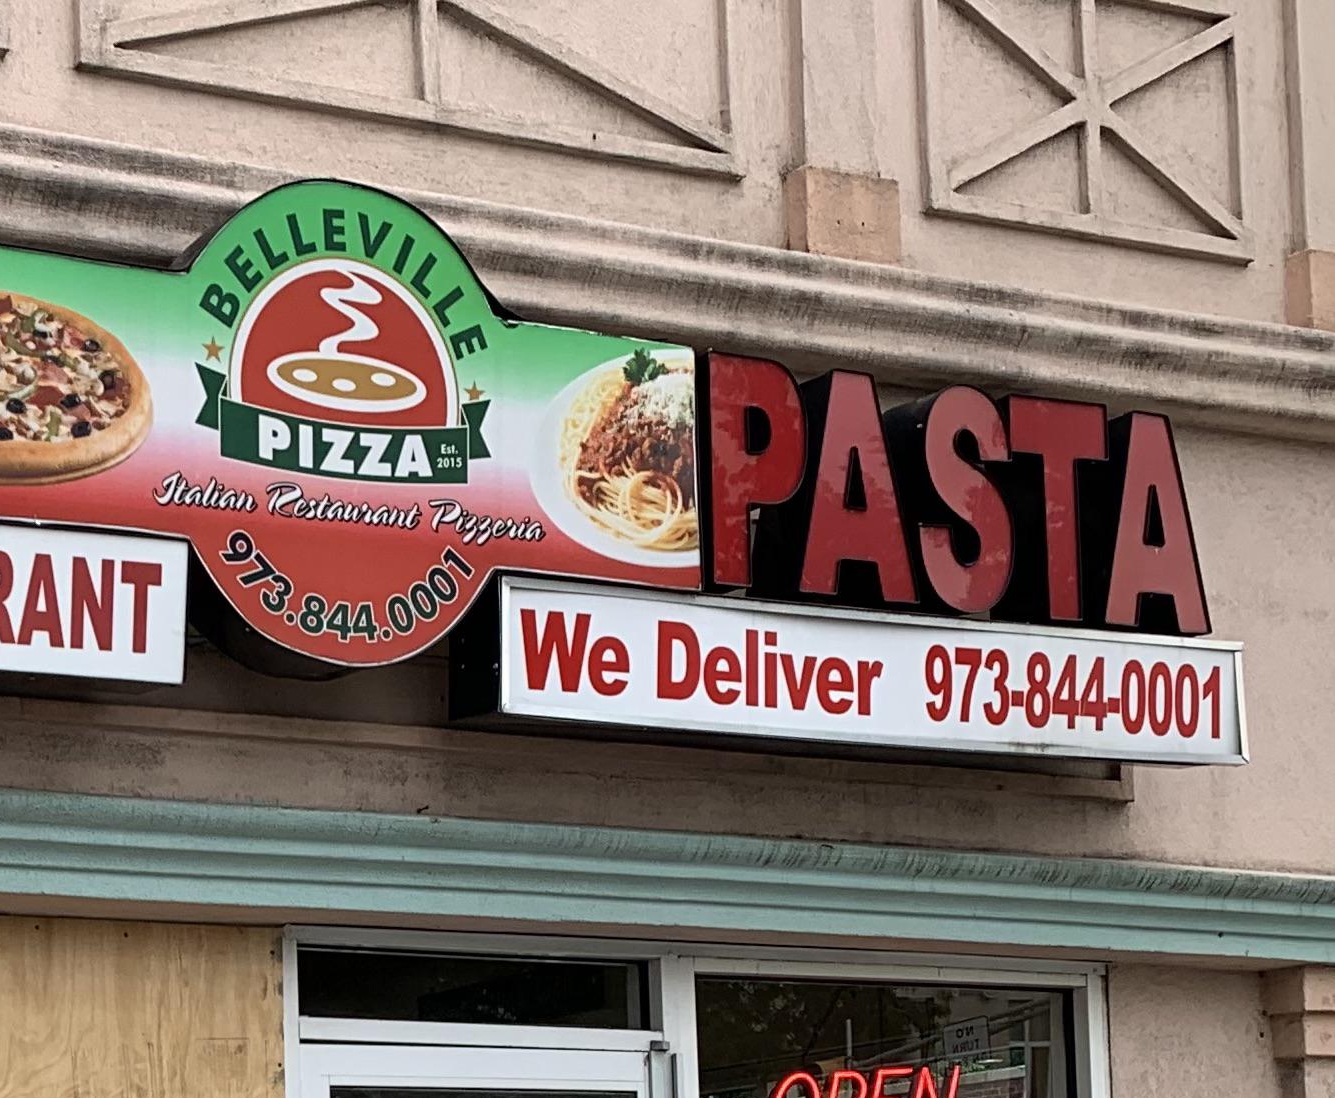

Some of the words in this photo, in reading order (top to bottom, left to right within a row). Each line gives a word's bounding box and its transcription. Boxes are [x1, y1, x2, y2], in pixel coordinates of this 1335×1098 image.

[198, 208, 488, 361] BELLEVILLE
[257, 413, 435, 479] PIZZA
[436, 456, 464, 469] 2015
[439, 442, 460, 456] Est.
[707, 350, 1213, 636] PASTA
[153, 470, 258, 513] Italian
[266, 481, 424, 530] Restaurant
[429, 499, 547, 545] Pizzeria
[219, 528, 476, 643] 973.844.0001
[520, 608, 631, 698] We
[656, 619, 883, 717] Deliver
[924, 643, 1222, 741] 973-844-0001
